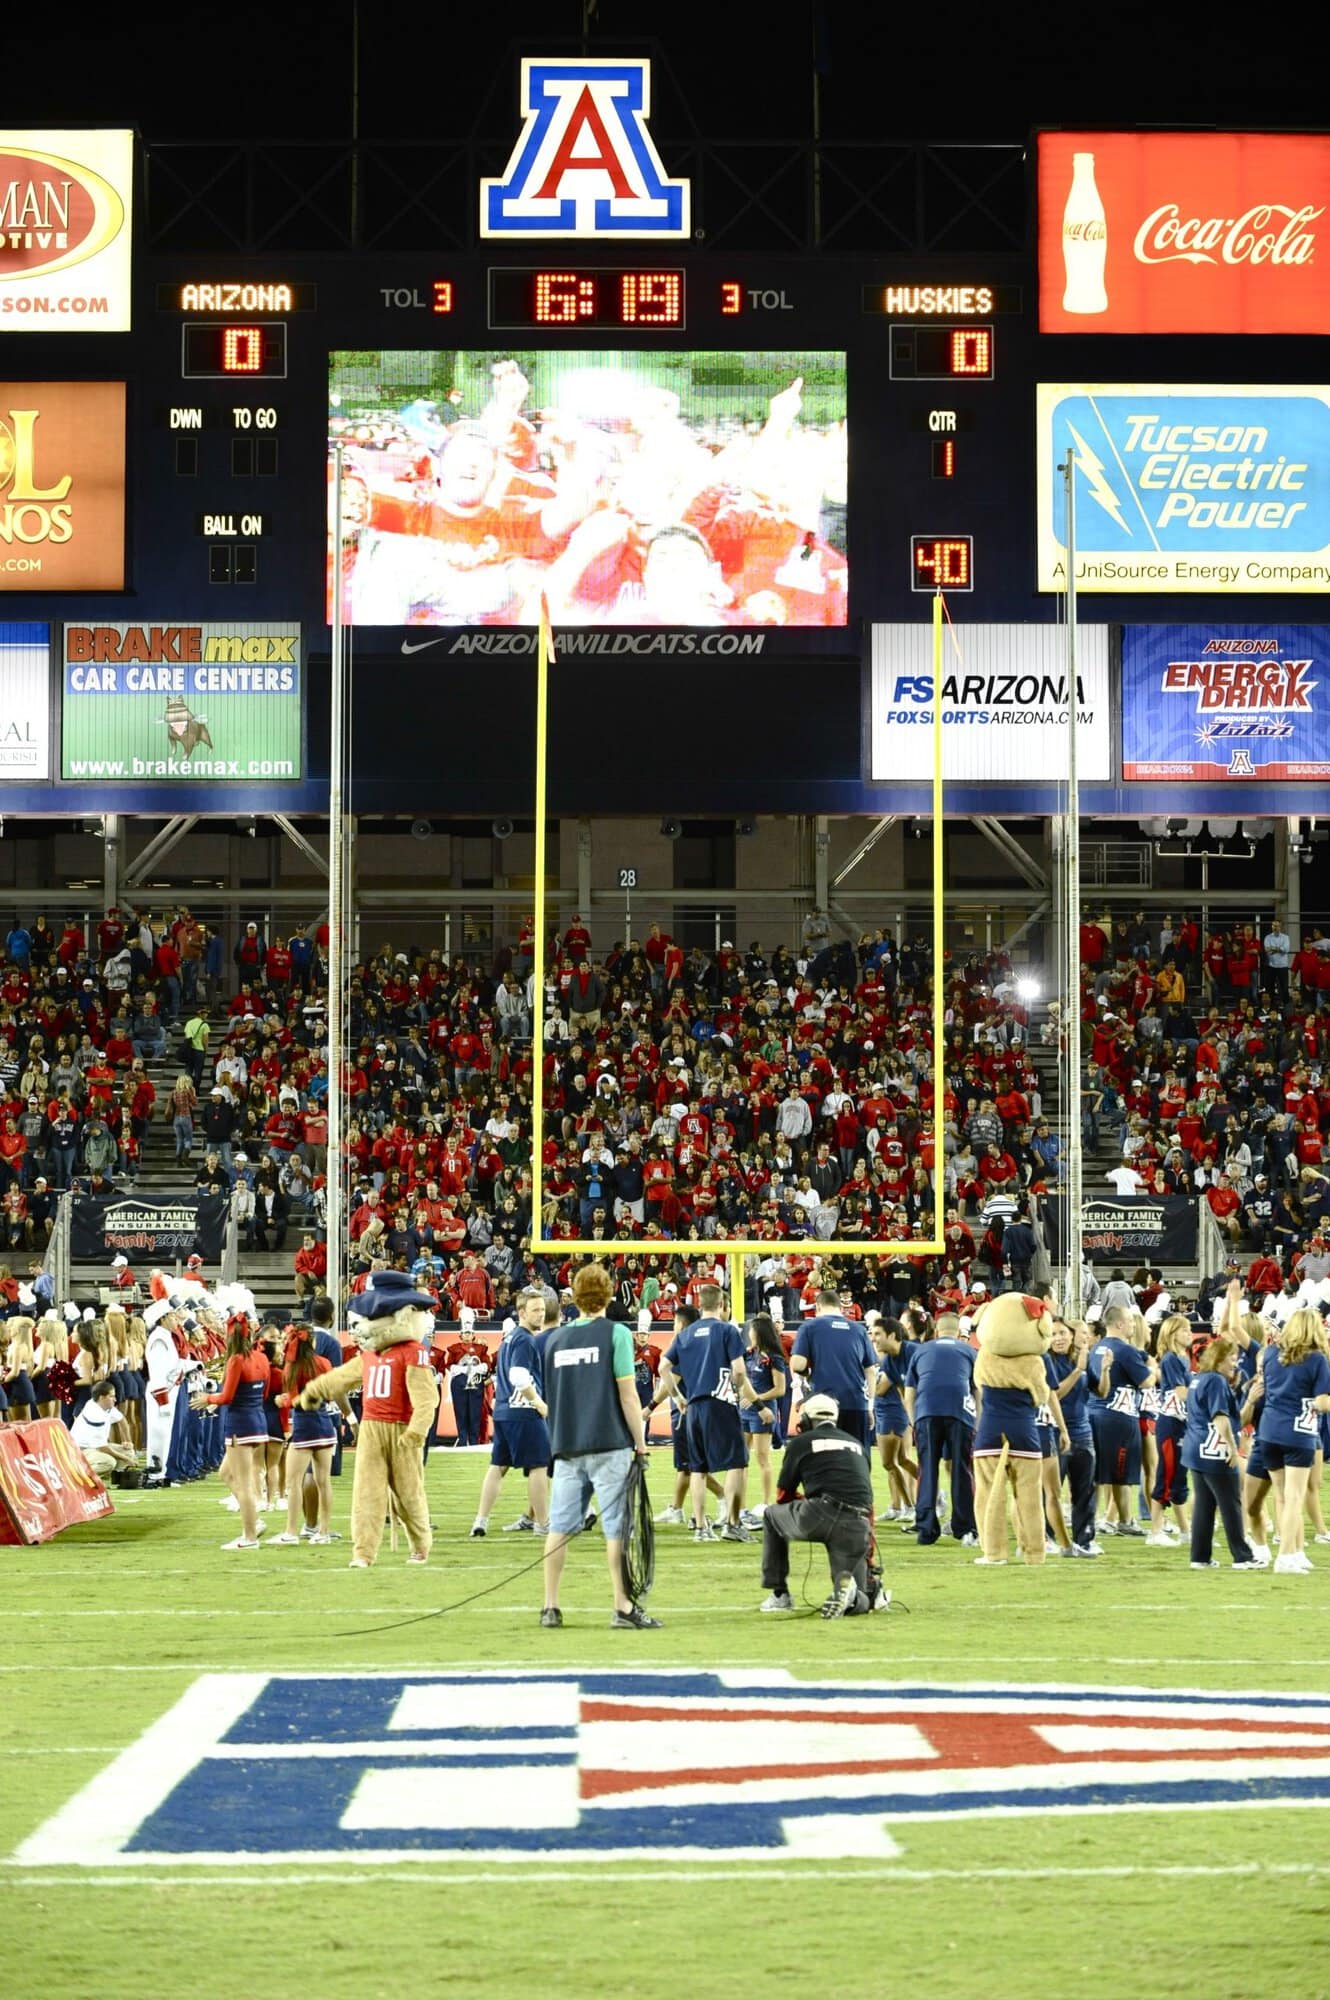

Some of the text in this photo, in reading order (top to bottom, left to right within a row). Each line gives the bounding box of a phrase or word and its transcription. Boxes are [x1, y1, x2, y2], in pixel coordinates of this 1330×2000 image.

[480, 58, 691, 238] A
[1133, 204, 1326, 265] Coca-Cola
[181, 284, 292, 312] ARIZONA
[381, 282, 451, 312] TOL 3
[536, 274, 680, 322] 6:19
[722, 284, 794, 313] 3 TOL
[885, 287, 993, 314] HUSKIES
[224, 329, 260, 371] 0
[952, 332, 989, 372] 0
[170, 408, 202, 429] DWN
[233, 408, 277, 429] TO GO
[928, 410, 957, 432] QTR
[1123, 415, 1268, 453] Tucson
[1138, 455, 1308, 490] Electric
[1156, 493, 1308, 529] Power
[204, 515, 262, 536] BALL ON
[916, 542, 968, 584] 40
[1175, 562, 1240, 582] Energy
[66, 626, 299, 663] BRAKE max
[1202, 640, 1279, 654] ARIZONA
[70, 667, 294, 692] CAR CARE CENTERS
[1166, 662, 1308, 688] ENERGY
[893, 675, 1085, 704] FS ARIZONA
[1200, 683, 1310, 708] DRINK
[886, 710, 1094, 725] FOXSORTSARIZONA.CM
[0, 721, 37, 742] AL
[70, 757, 293, 776] www.brakemax.com
[620, 869, 636, 887] 28
[106, 1212, 196, 1222] AMERICAN FAMILY
[1081, 1211, 1163, 1221] MERICAN FAMILY
[1254, 1201, 1272, 1216] 32
[553, 1346, 600, 1369] ESPN
[366, 1365, 392, 1398] 10
[811, 1438, 863, 1456] ESPN
